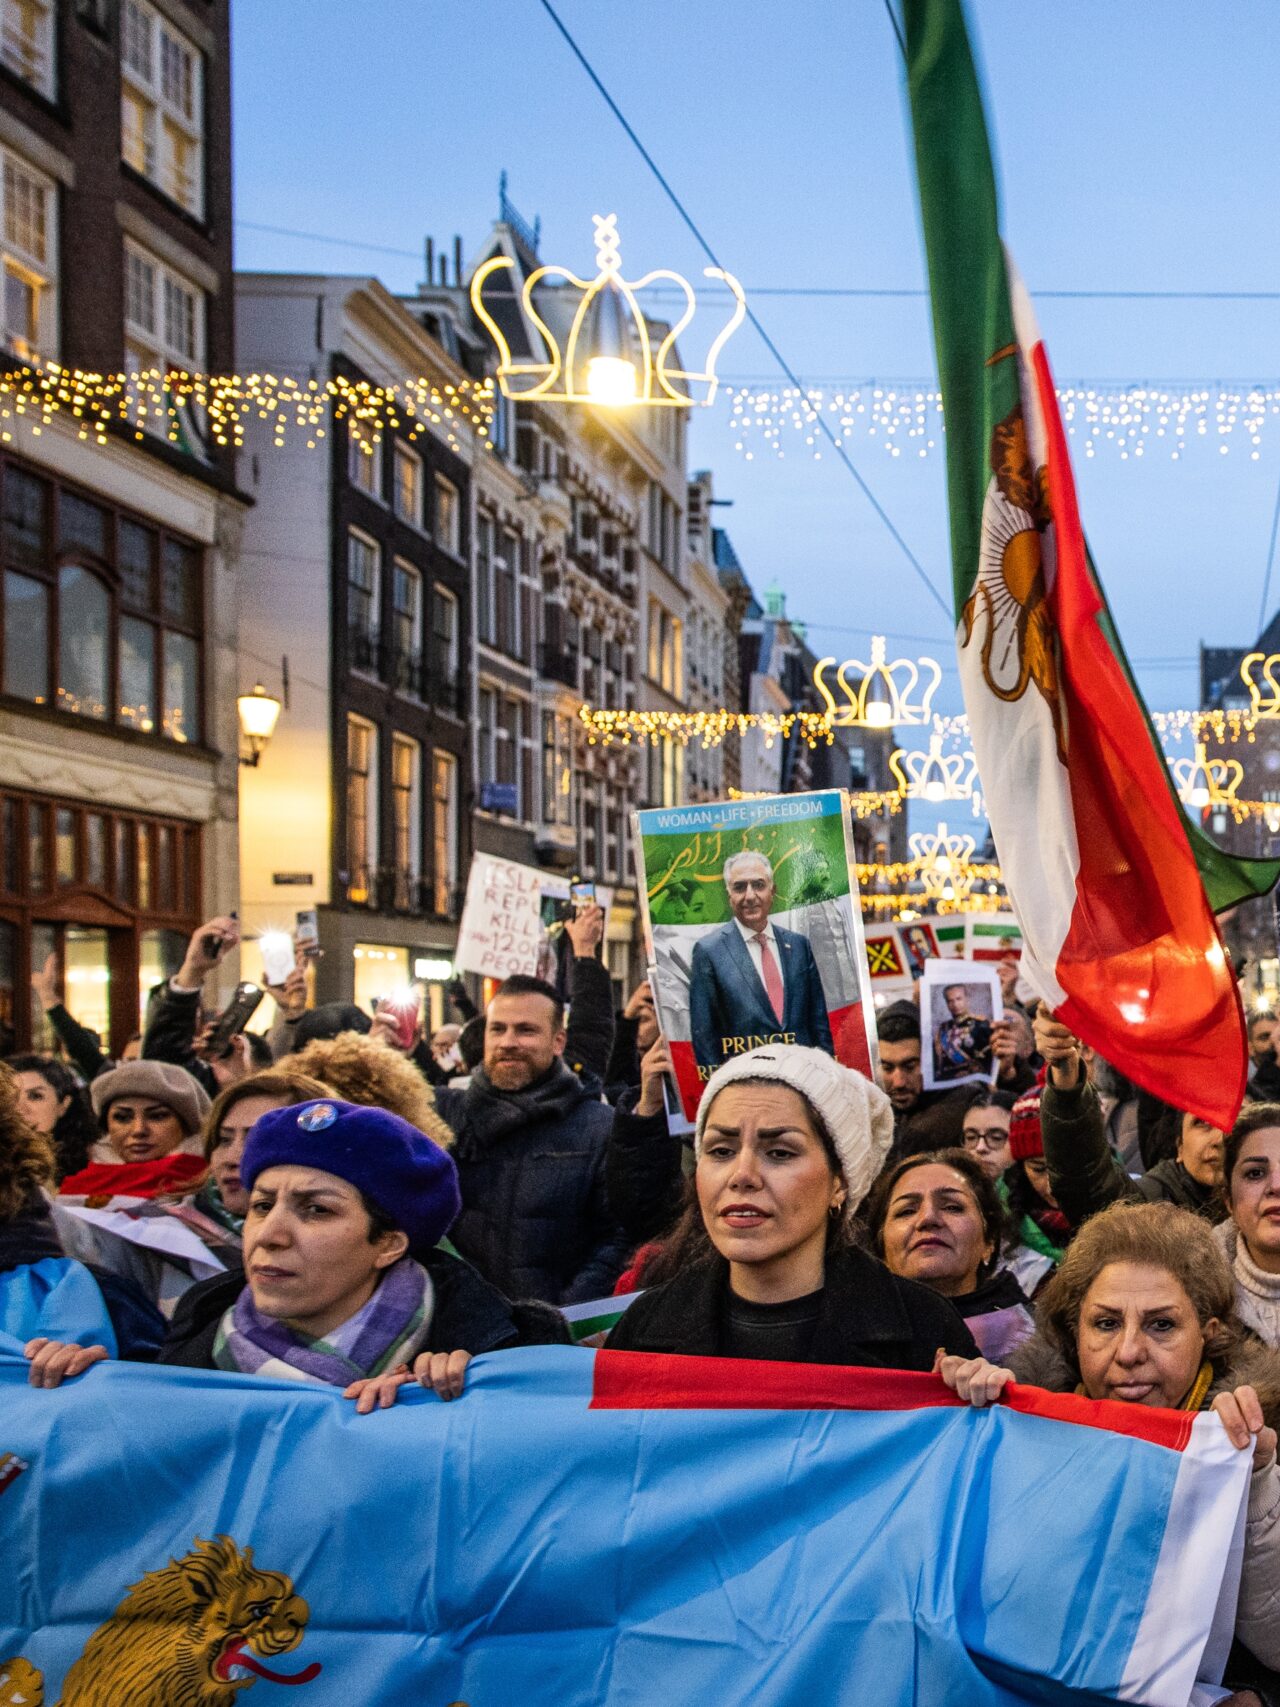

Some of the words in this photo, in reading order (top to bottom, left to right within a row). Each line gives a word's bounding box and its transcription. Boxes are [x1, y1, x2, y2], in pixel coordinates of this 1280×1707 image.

[658, 811, 712, 828] WOMAN
[720, 808, 747, 824] LIFE
[757, 800, 823, 818] FREEDOM
[490, 912, 532, 936] KILL
[721, 1032, 796, 1055] PRINCE
